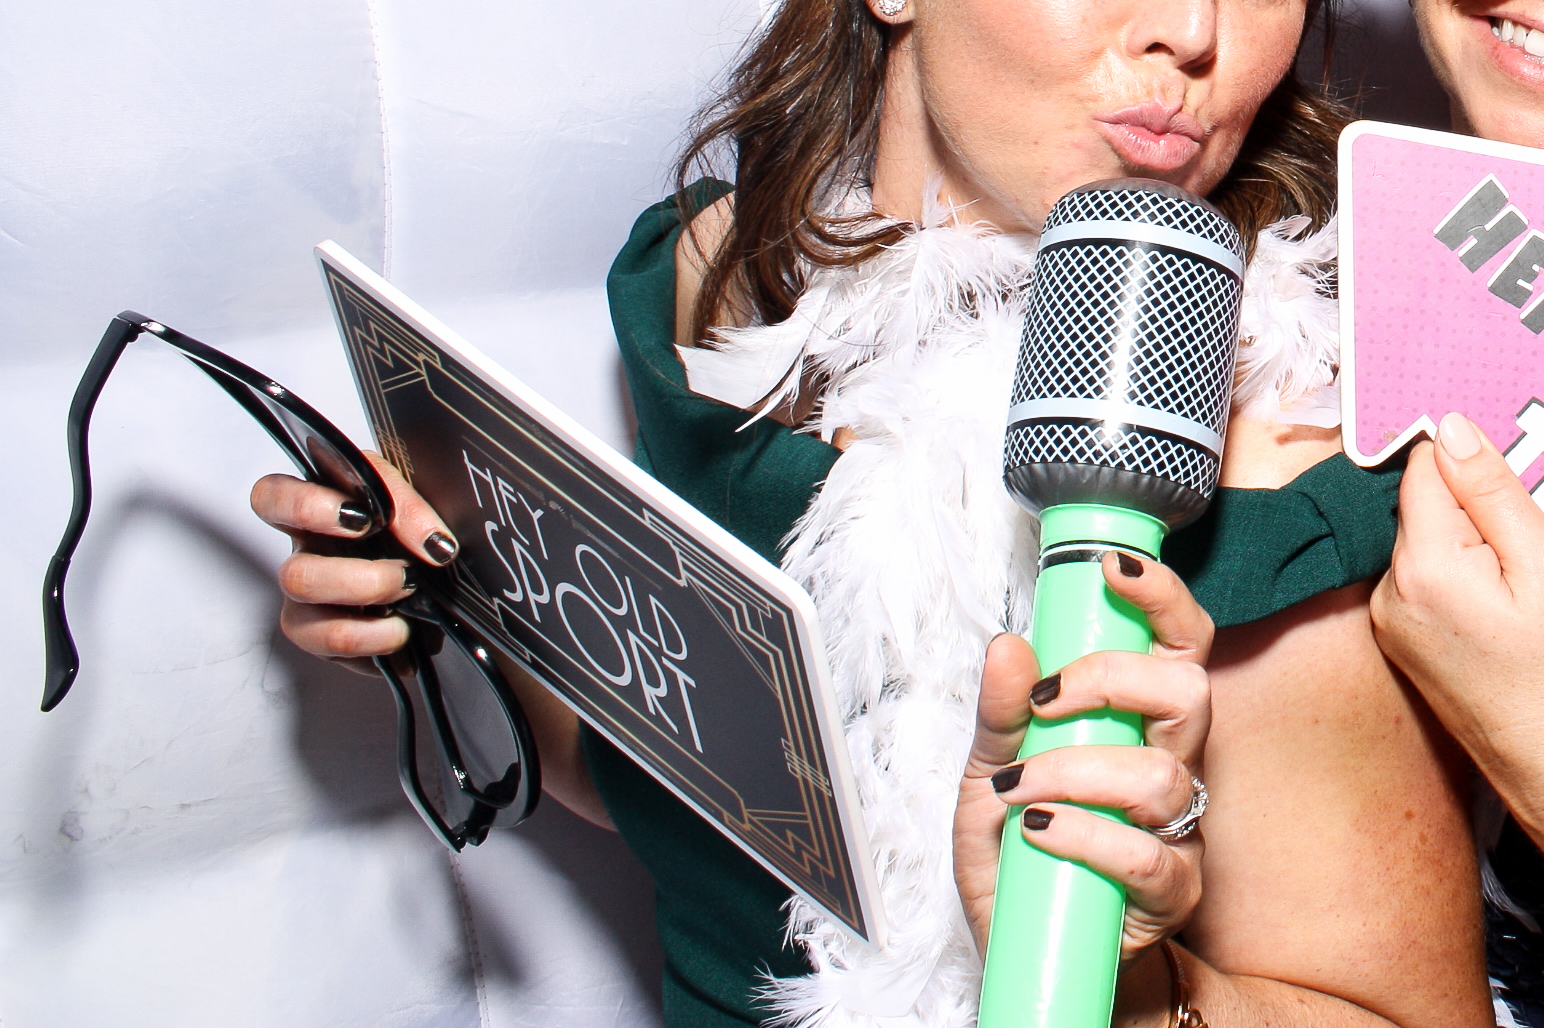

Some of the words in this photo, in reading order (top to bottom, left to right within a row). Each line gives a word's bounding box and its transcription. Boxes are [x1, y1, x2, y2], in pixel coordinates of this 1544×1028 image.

[461, 449, 545, 560] HEY
[575, 543, 689, 662] OLD
[485, 519, 704, 755] SPORT
